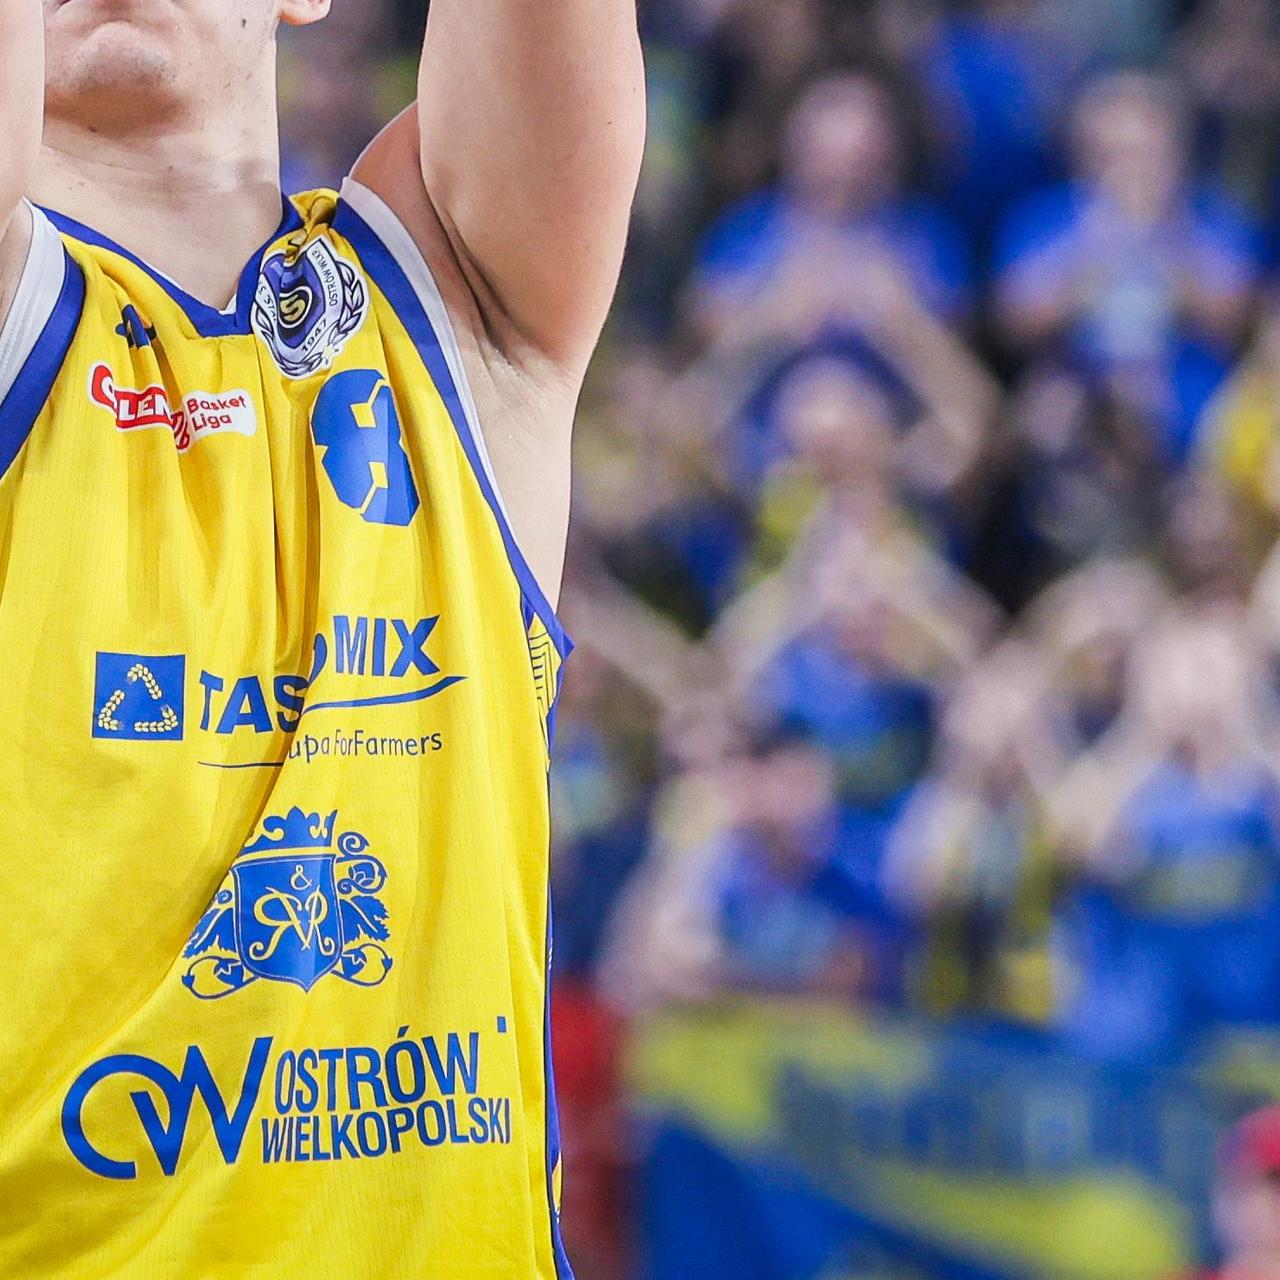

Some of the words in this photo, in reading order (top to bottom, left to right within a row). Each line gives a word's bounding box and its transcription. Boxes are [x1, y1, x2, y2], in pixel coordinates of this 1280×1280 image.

[301, 318, 327, 352] 1947
[186, 394, 246, 414] Basket
[192, 412, 233, 432] Liga
[275, 1026, 480, 1115] OSTRÓW
[262, 1097, 511, 1165] WIELKOPOLSKI
